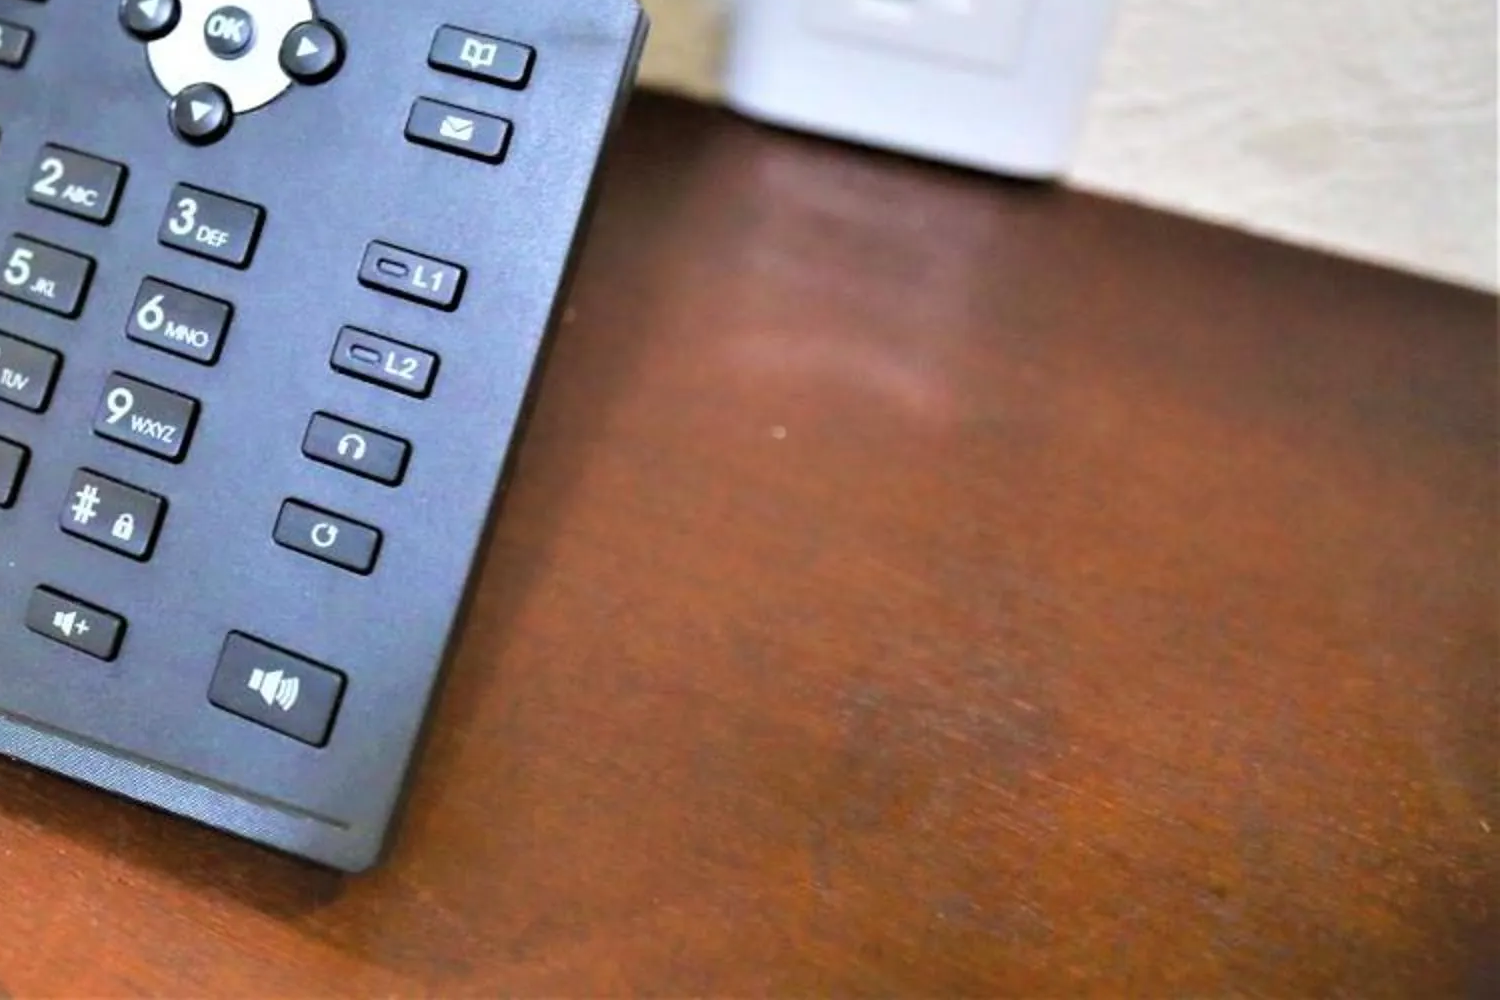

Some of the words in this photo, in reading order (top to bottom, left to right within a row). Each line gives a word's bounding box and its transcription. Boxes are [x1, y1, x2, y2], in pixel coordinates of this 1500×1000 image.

[208, 14, 244, 42] OK
[32, 157, 64, 196] 2
[61, 184, 98, 207] ABC
[168, 198, 197, 235] 3
[196, 225, 230, 247] DEF
[3, 247, 34, 285] 5
[412, 265, 444, 292] L1
[137, 294, 165, 331] 6
[164, 321, 209, 348] MNO
[0, 368, 30, 391] TUV
[384, 351, 419, 380] L2
[106, 387, 134, 424] 9
[131, 415, 176, 443] WXYZ
